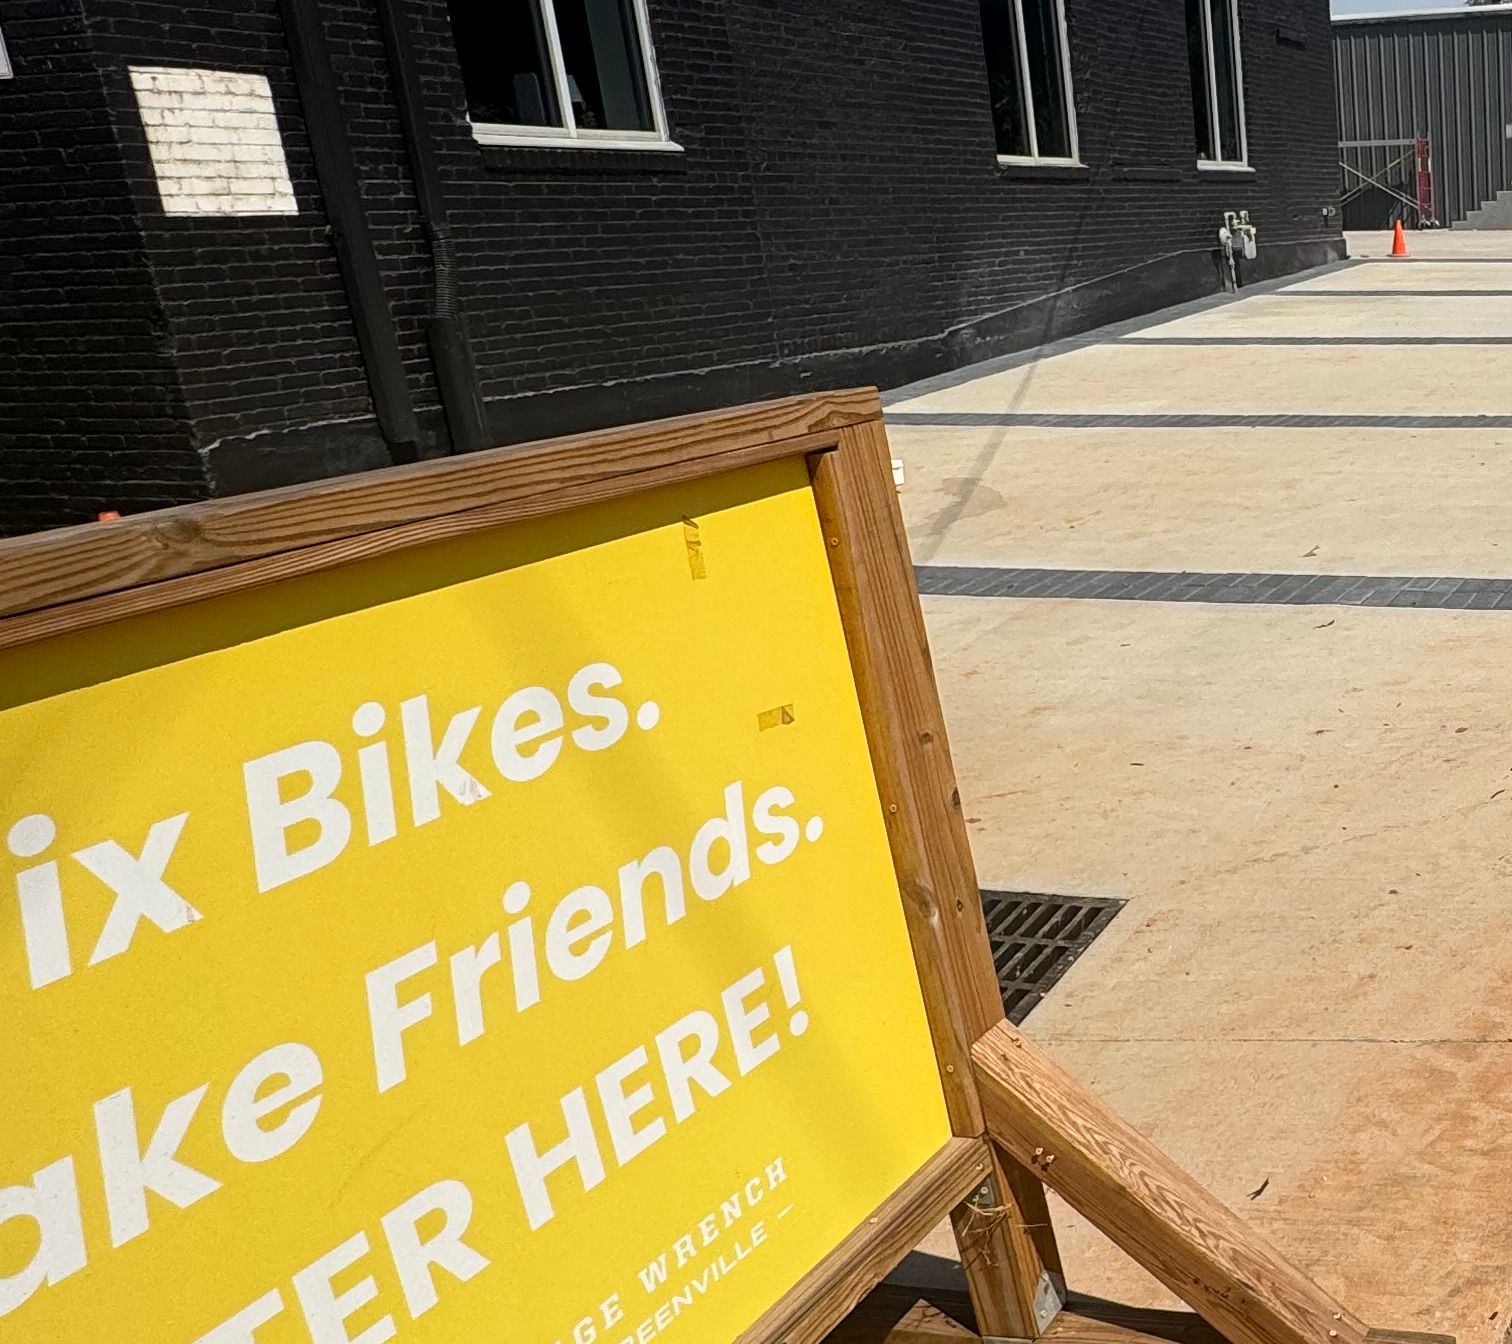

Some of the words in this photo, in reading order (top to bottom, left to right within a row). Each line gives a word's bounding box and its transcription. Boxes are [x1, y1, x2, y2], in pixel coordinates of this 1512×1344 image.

[242, 661, 662, 893] Bikes.
[364, 779, 825, 1094] Friends.
[504, 944, 810, 1232] HERE!
[637, 1156, 788, 1294] WRENCH
